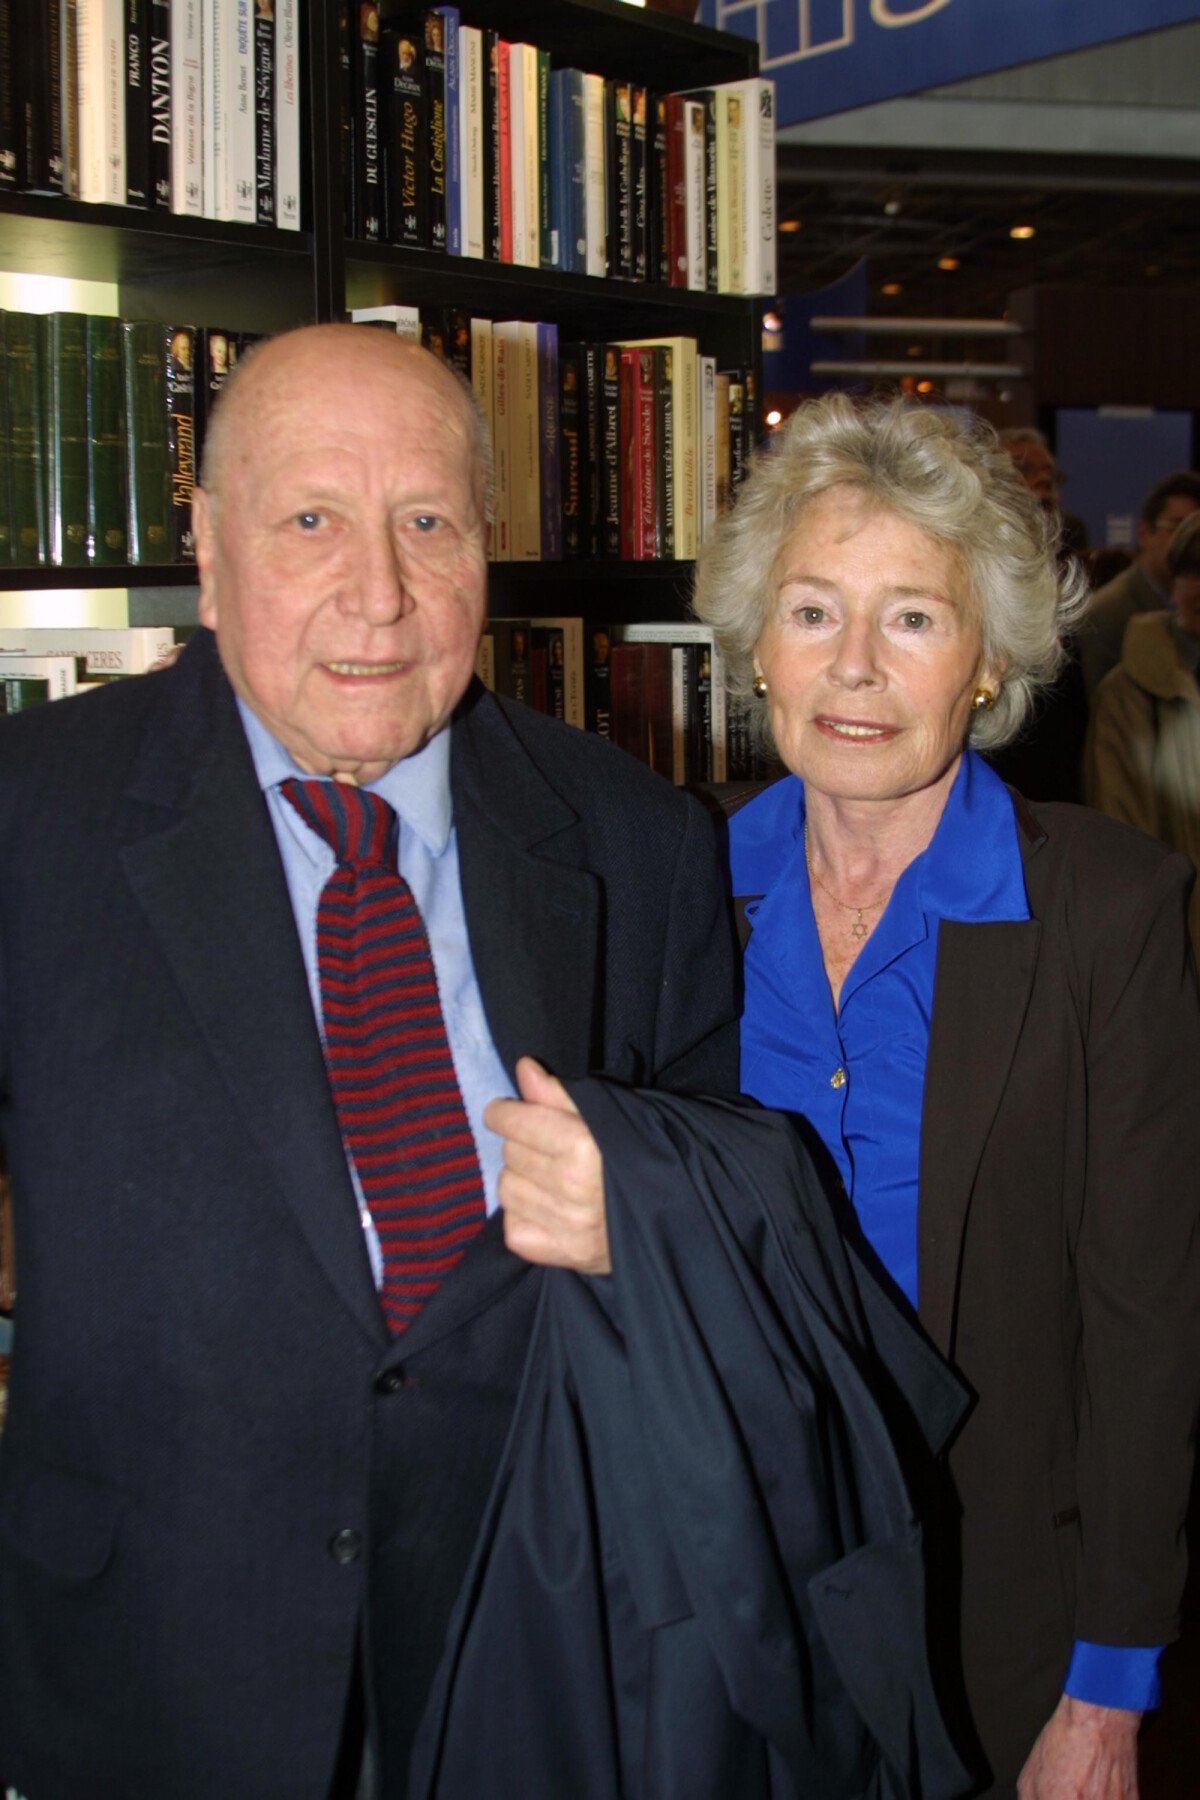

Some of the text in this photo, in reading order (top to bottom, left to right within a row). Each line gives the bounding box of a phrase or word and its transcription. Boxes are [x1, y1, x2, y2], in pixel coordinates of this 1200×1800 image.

[236, 19, 247, 54] ENQUÊTE
[284, 0, 293, 18] Blan
[128, 34, 140, 88] FRANCO
[151, 36, 171, 145] DANTON
[256, 42, 273, 100] Sévigné
[238, 94, 248, 114] Anne
[257, 103, 271, 122] de
[186, 127, 195, 165] Valtesse
[257, 125, 271, 191] Madame
[365, 87, 378, 184] DU GUESCLIN
[402, 101, 417, 208] Victor Hugo
[430, 100, 446, 194] La Castiglione
[759, 176, 773, 242] Colette
[497, 366, 506, 381] de
[497, 383, 507, 416] Gilles
[605, 405, 618, 466] d'Albret
[641, 402, 651, 447] Suède
[170, 414, 193, 506] Talleyrand
[563, 428, 579, 516] Surcouf
[705, 434, 714, 510] EDITH STEIN
[606, 470, 619, 525] Jeanne
[641, 464, 652, 525] Christine
